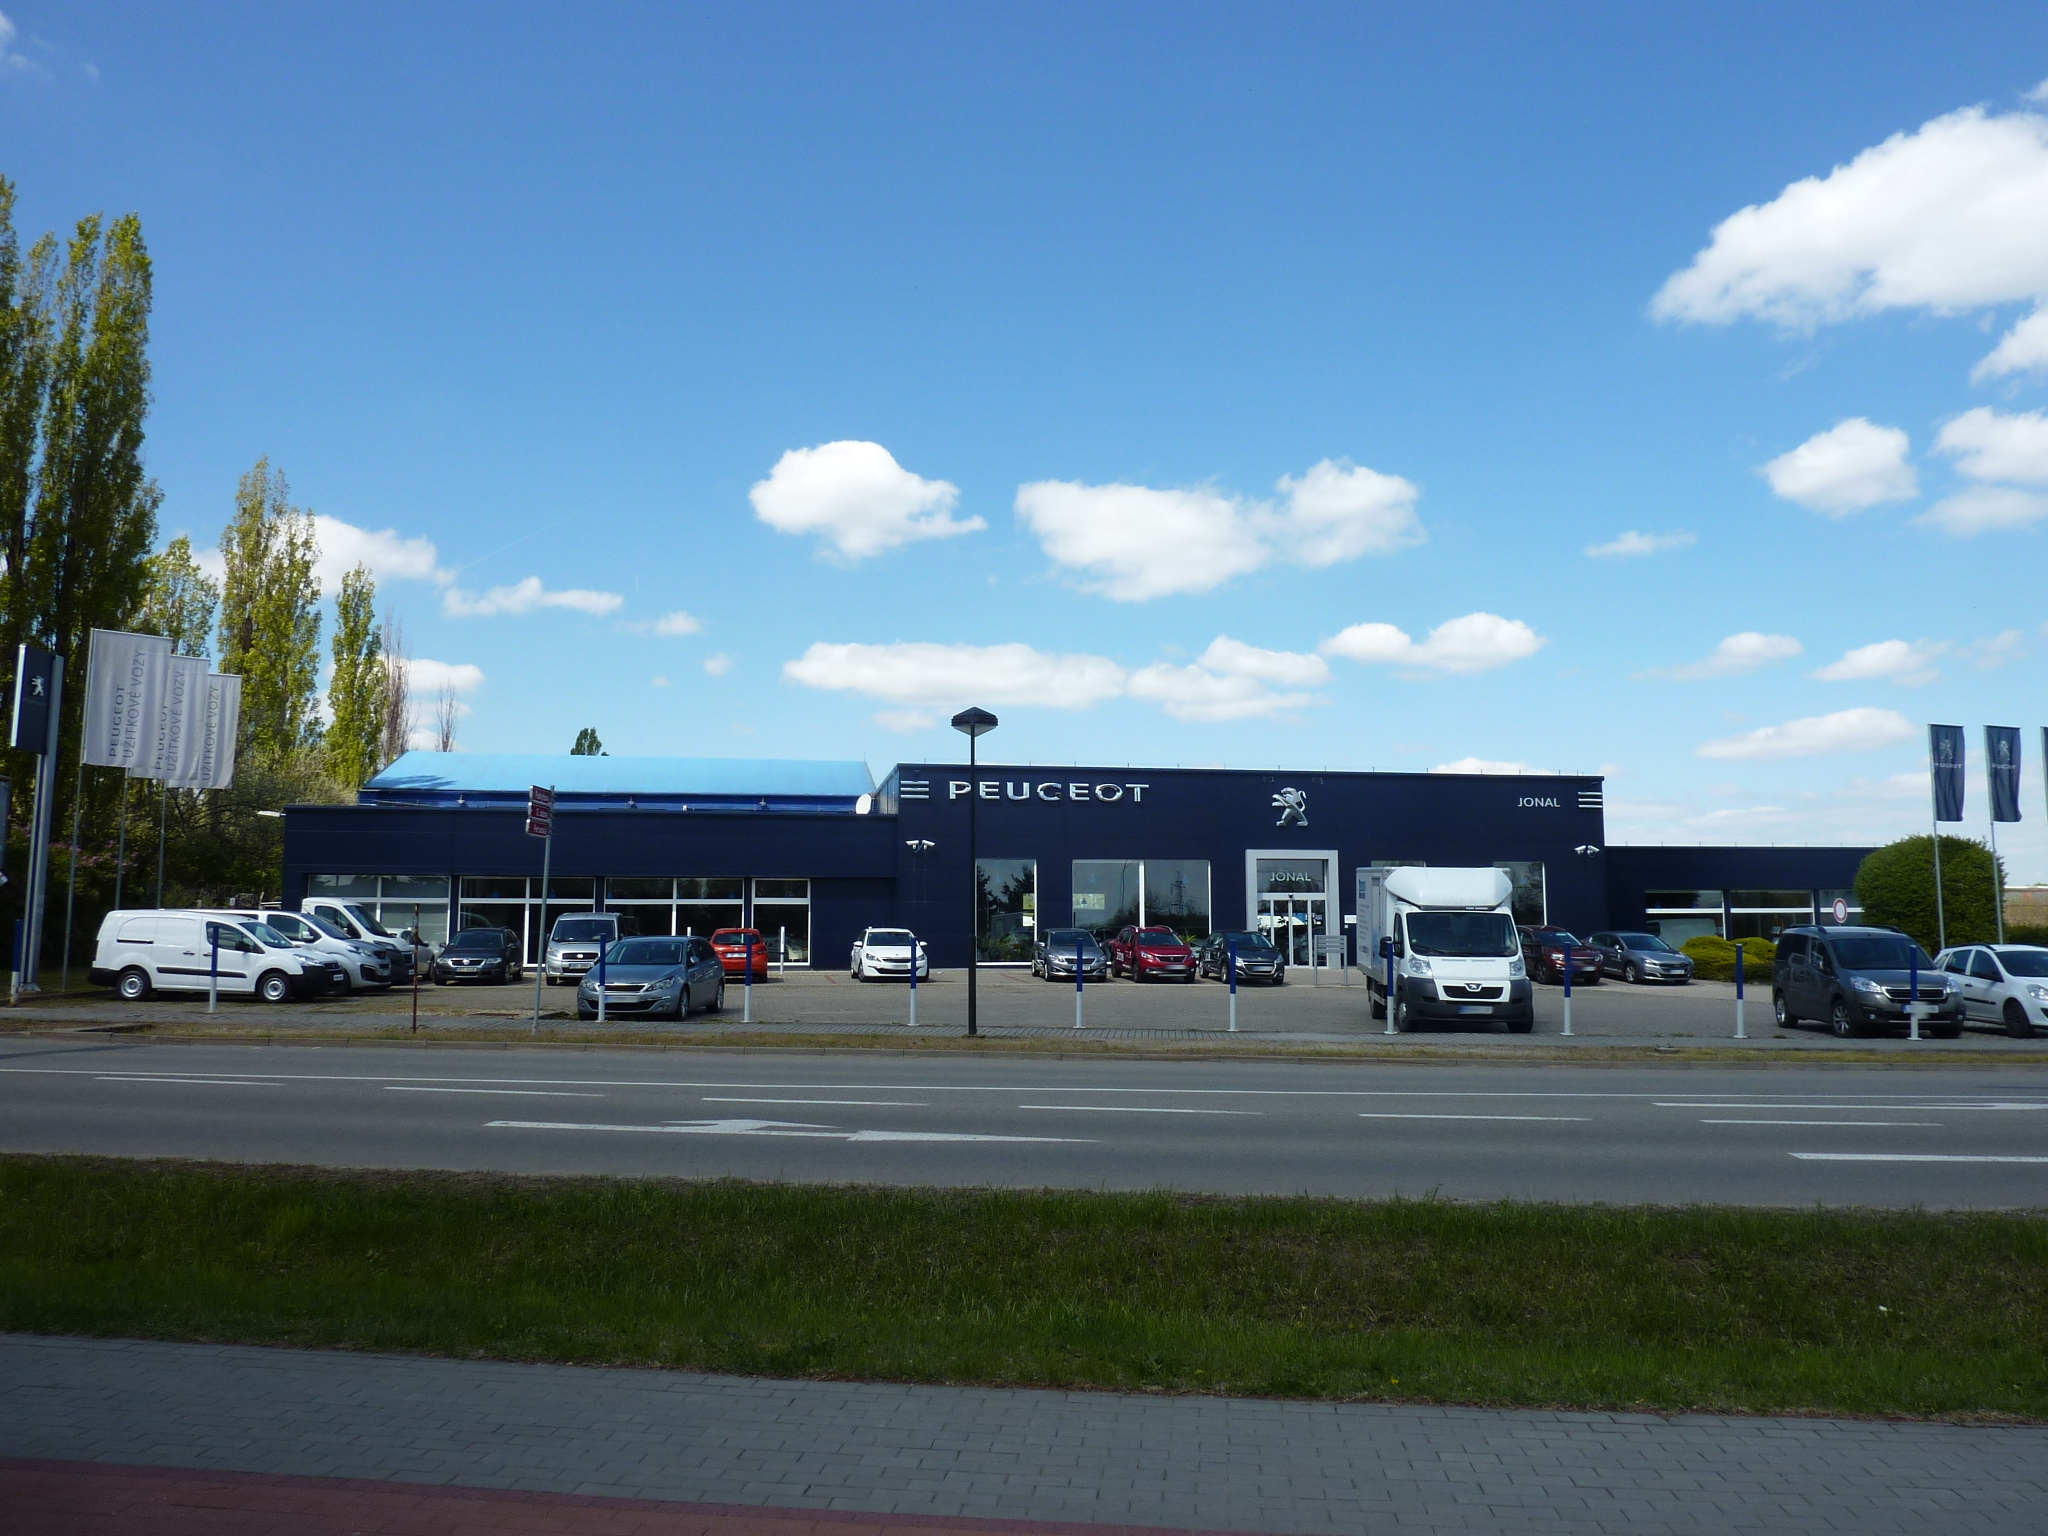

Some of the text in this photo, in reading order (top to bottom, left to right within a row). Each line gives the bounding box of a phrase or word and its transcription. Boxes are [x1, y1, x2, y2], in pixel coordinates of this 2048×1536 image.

[109, 685, 125, 757] PEUGEOT
[121, 650, 146, 758] UŽITKOVÉ VOZY
[165, 671, 186, 771] UŽITKOVÉ VOZY
[201, 686, 219, 780] UŽITKOVÉ VOZY
[949, 781, 1149, 802] PEUGEOT
[1517, 797, 1561, 807] JONAL
[1269, 872, 1312, 881] JONAL
